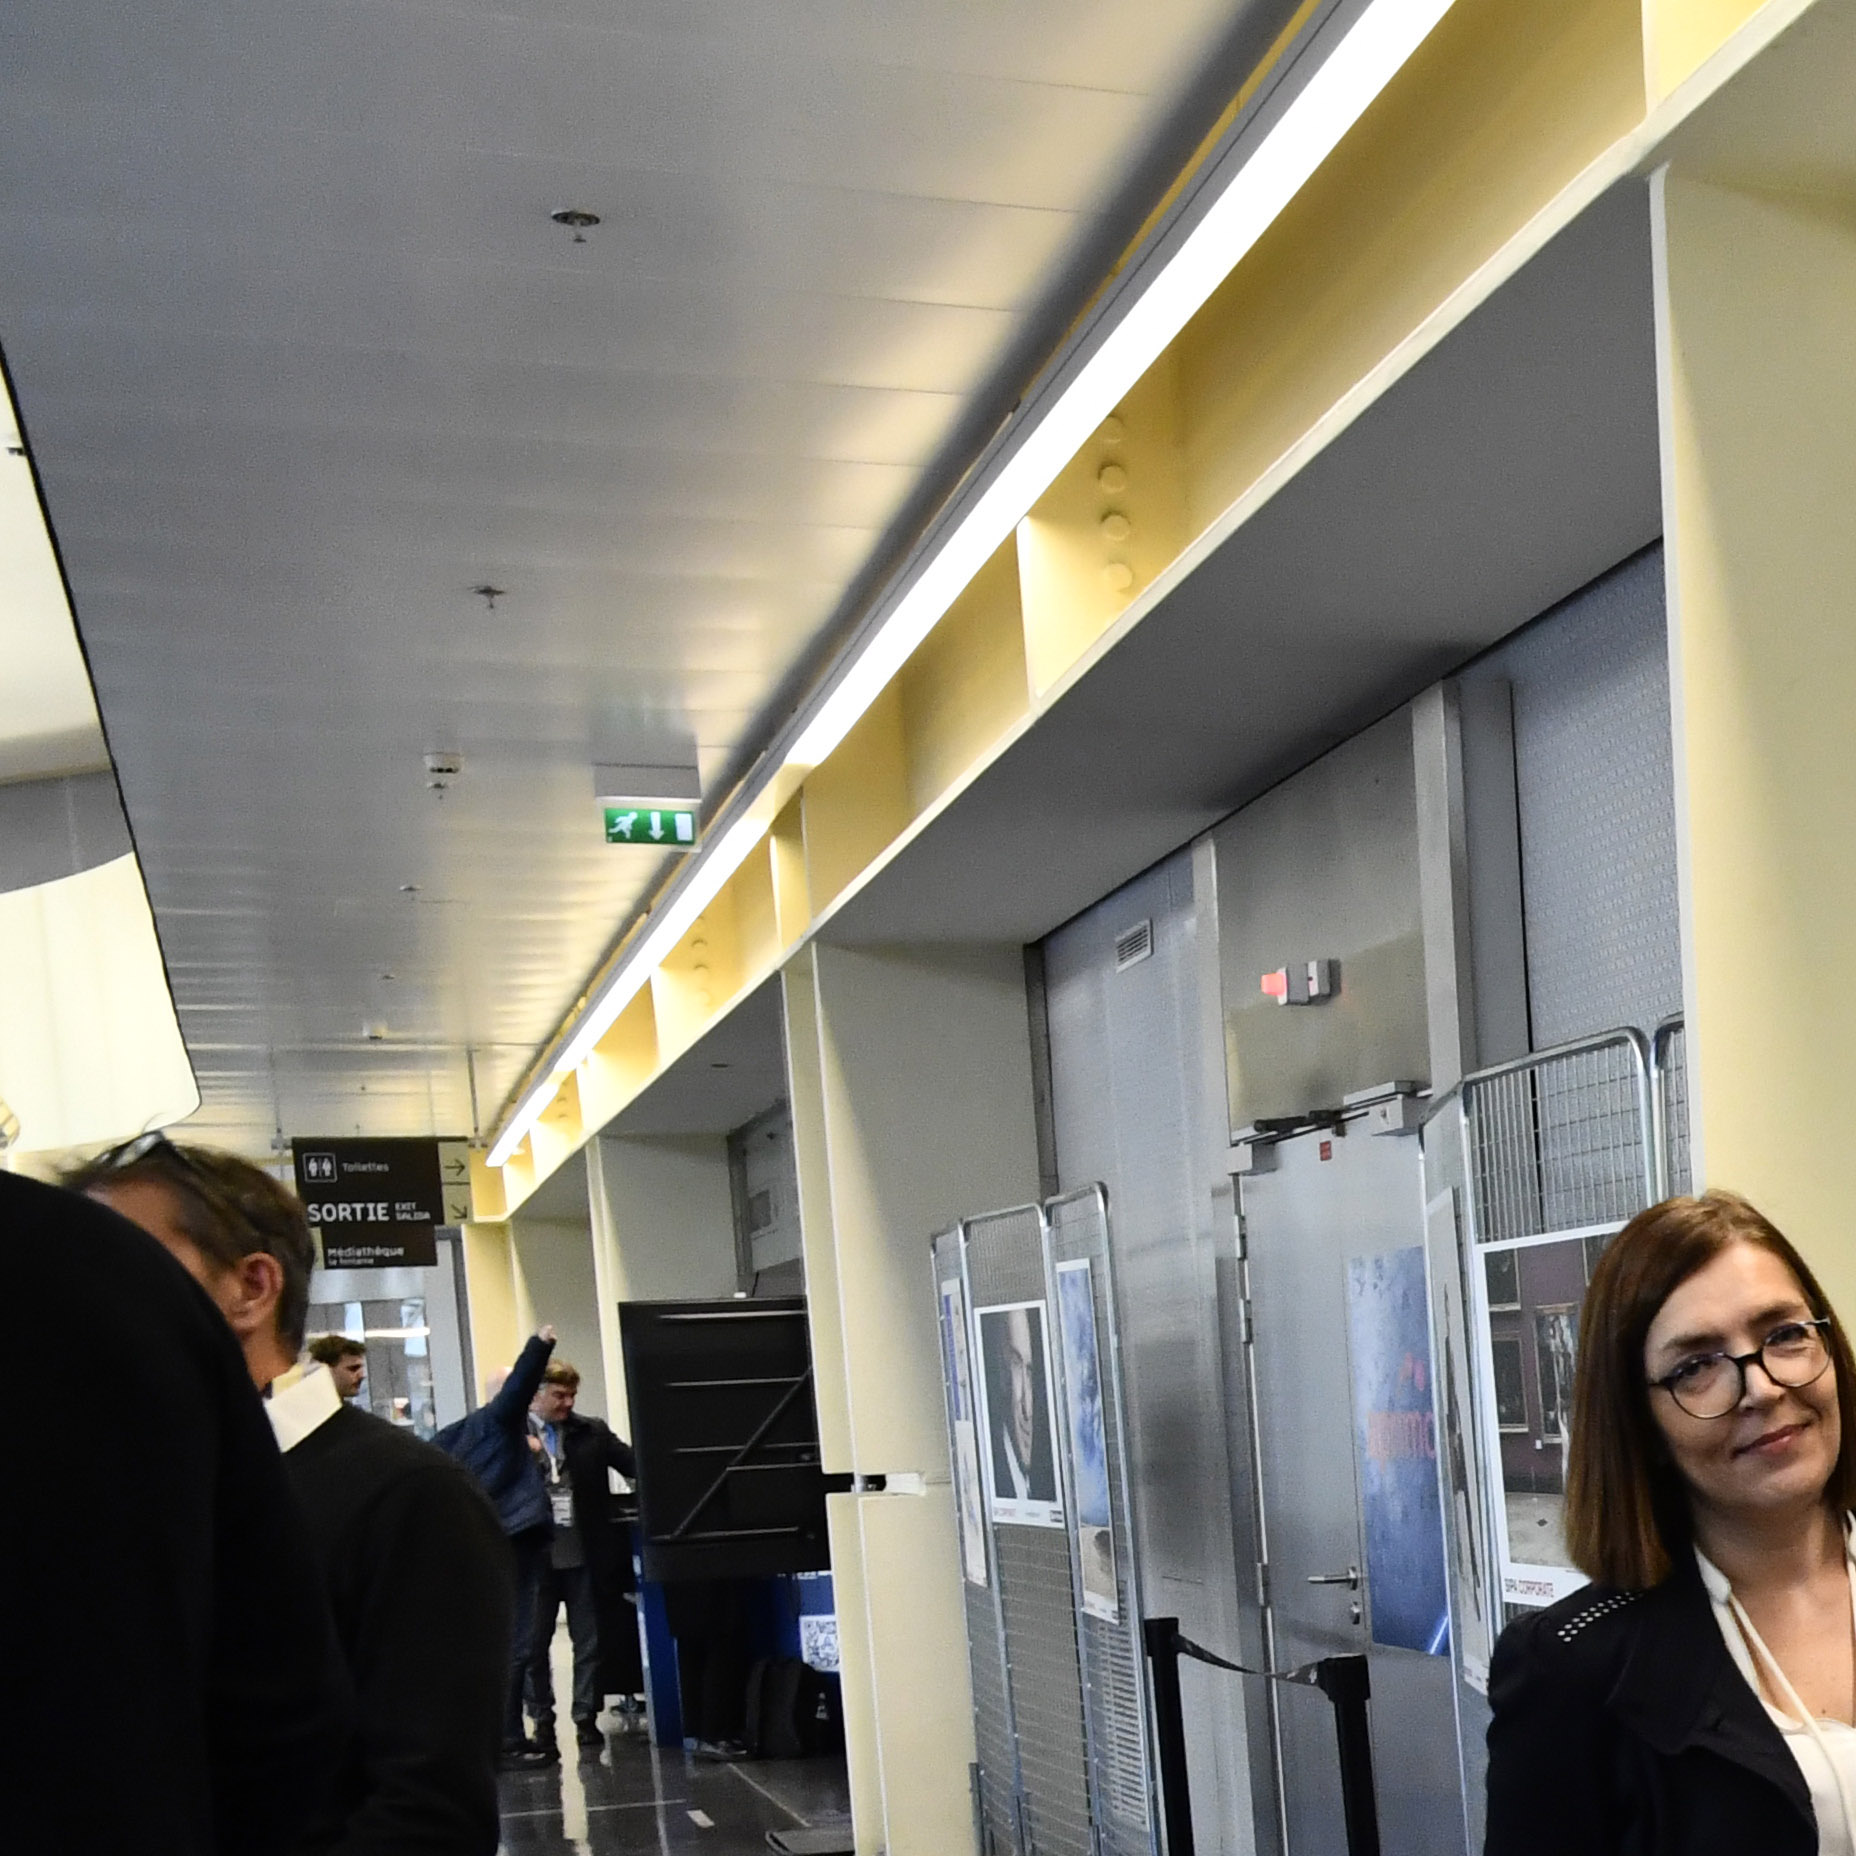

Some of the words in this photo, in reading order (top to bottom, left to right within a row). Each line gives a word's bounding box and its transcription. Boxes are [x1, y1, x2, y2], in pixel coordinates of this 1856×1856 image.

[342, 1162, 389, 1172] Toilettes
[395, 1202, 416, 1211] EXIT
[307, 1202, 390, 1222] SORTIE
